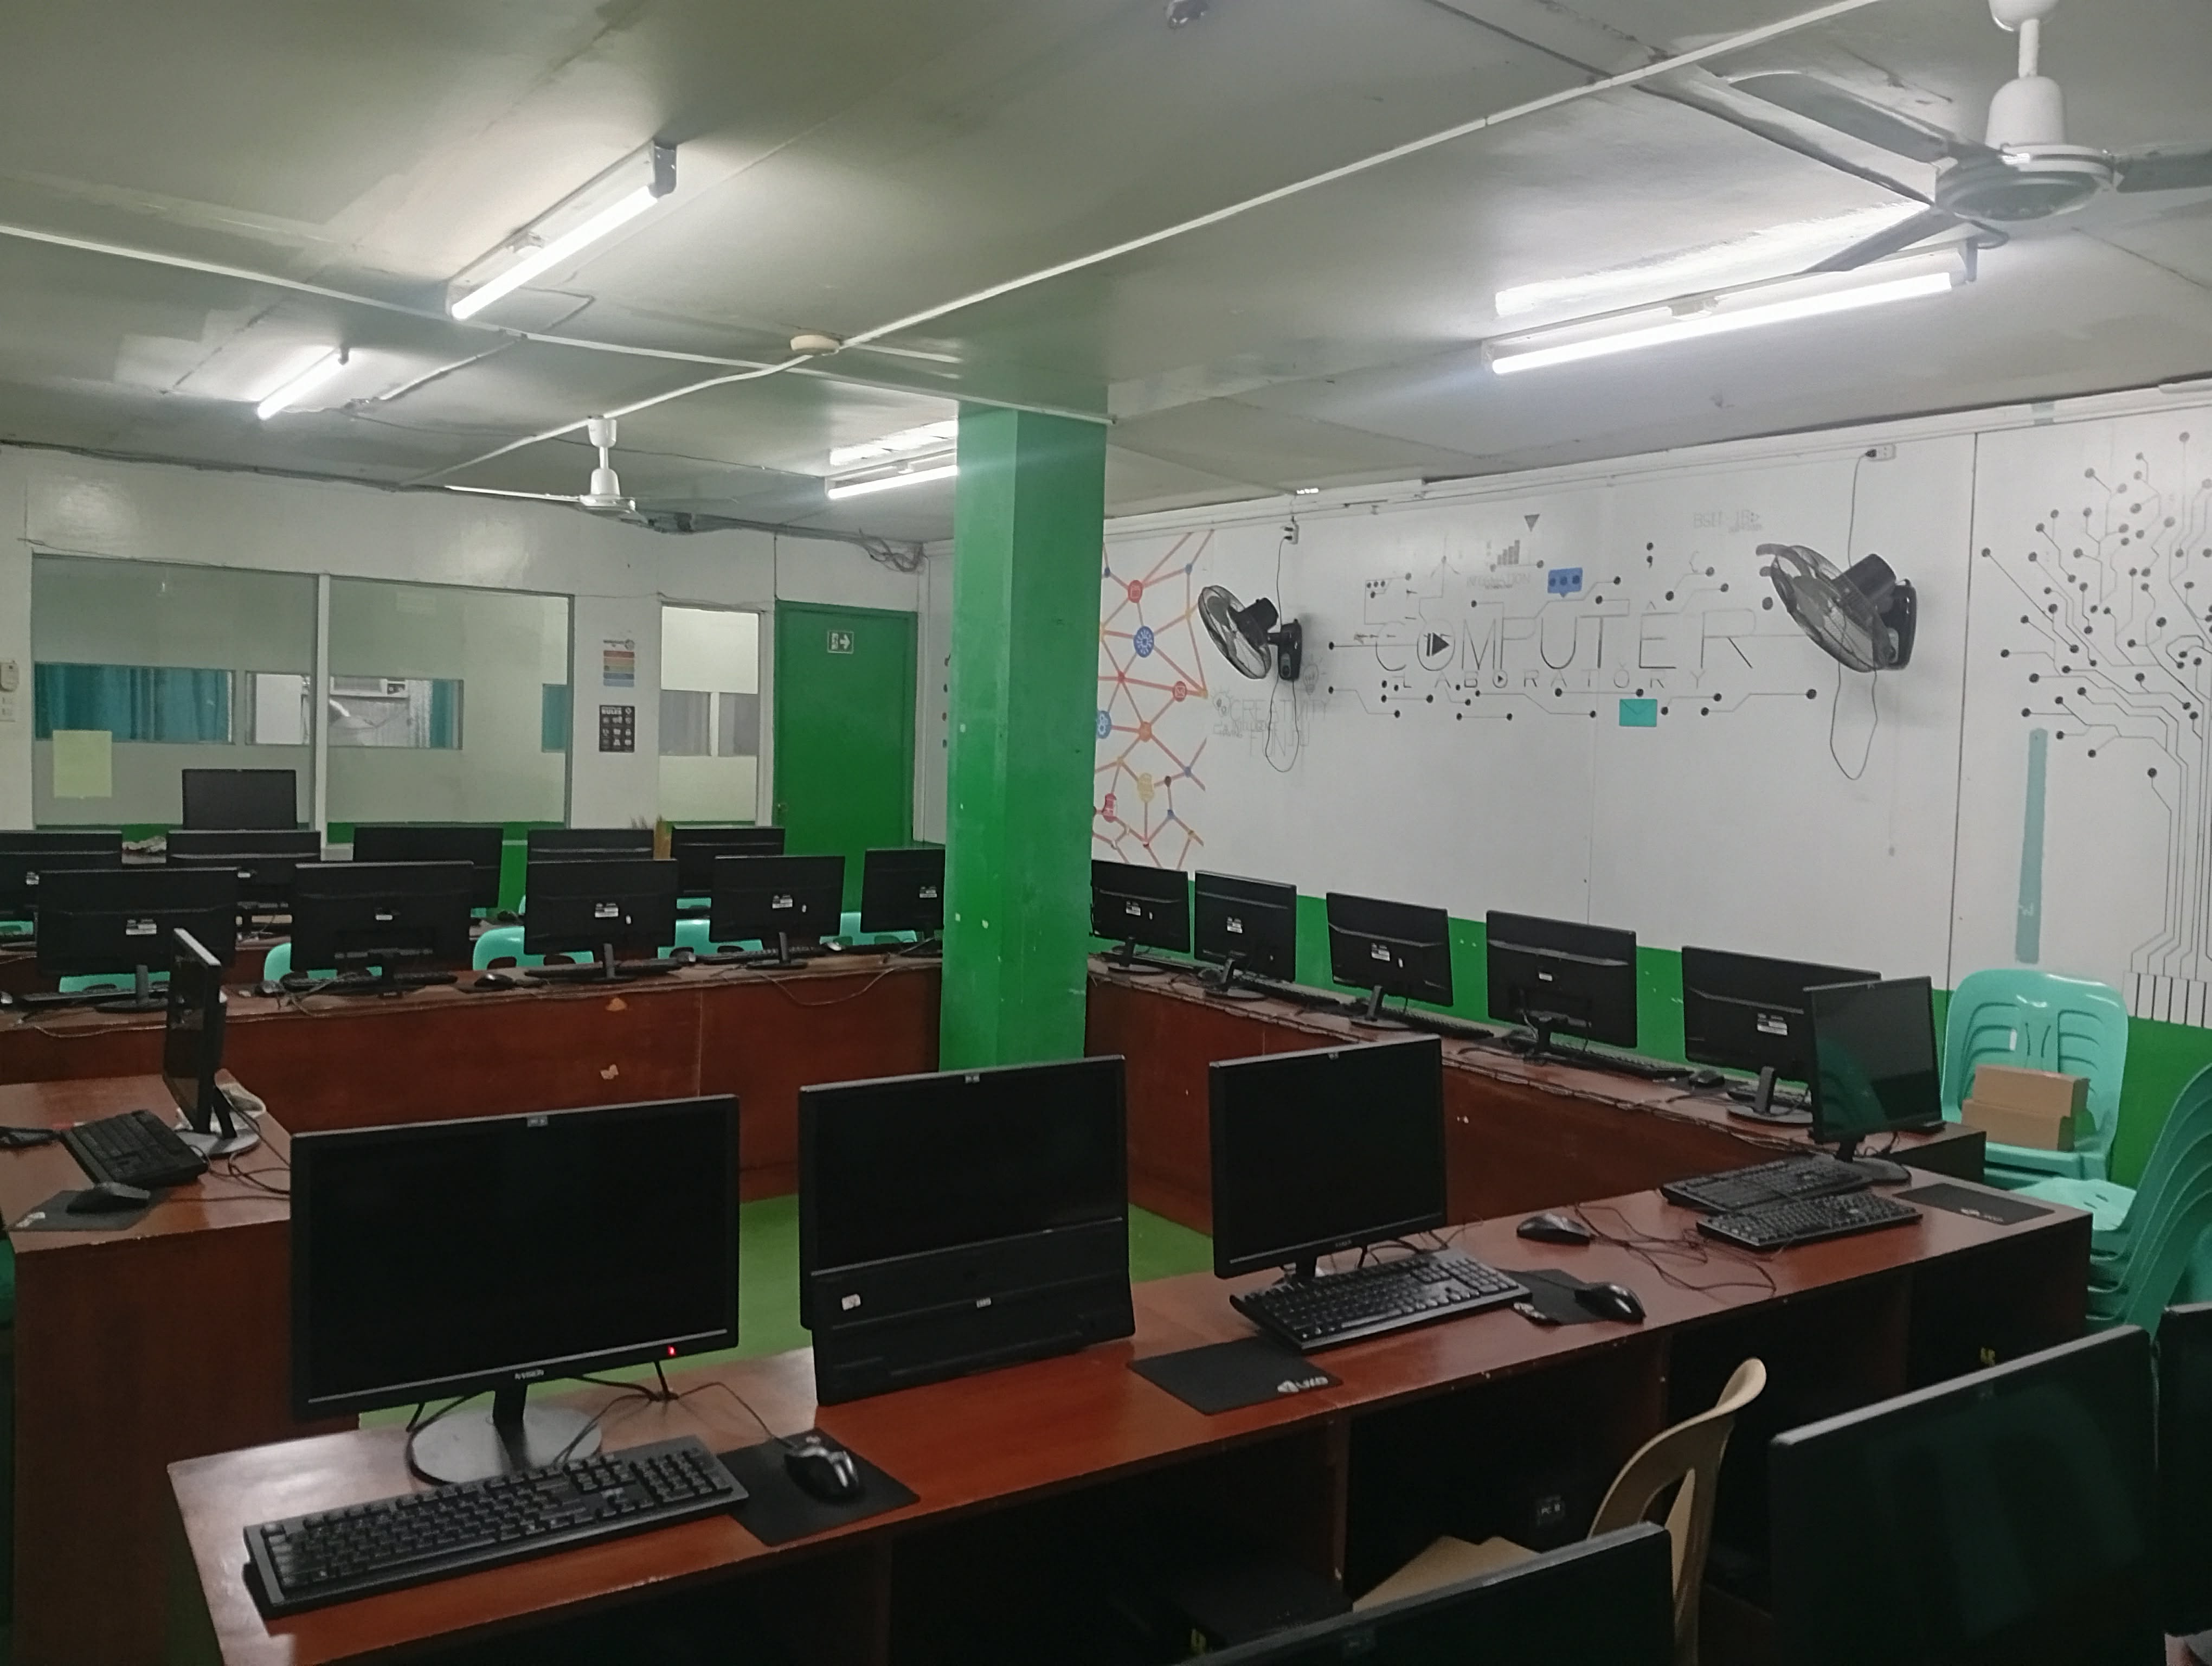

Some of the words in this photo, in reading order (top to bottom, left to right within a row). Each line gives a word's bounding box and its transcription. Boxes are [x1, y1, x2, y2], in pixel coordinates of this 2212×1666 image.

[1375, 607, 1756, 671] COMPUTER
[1392, 668, 1706, 689] LABORATORY
[1230, 699, 1330, 722] CREATIVITY
